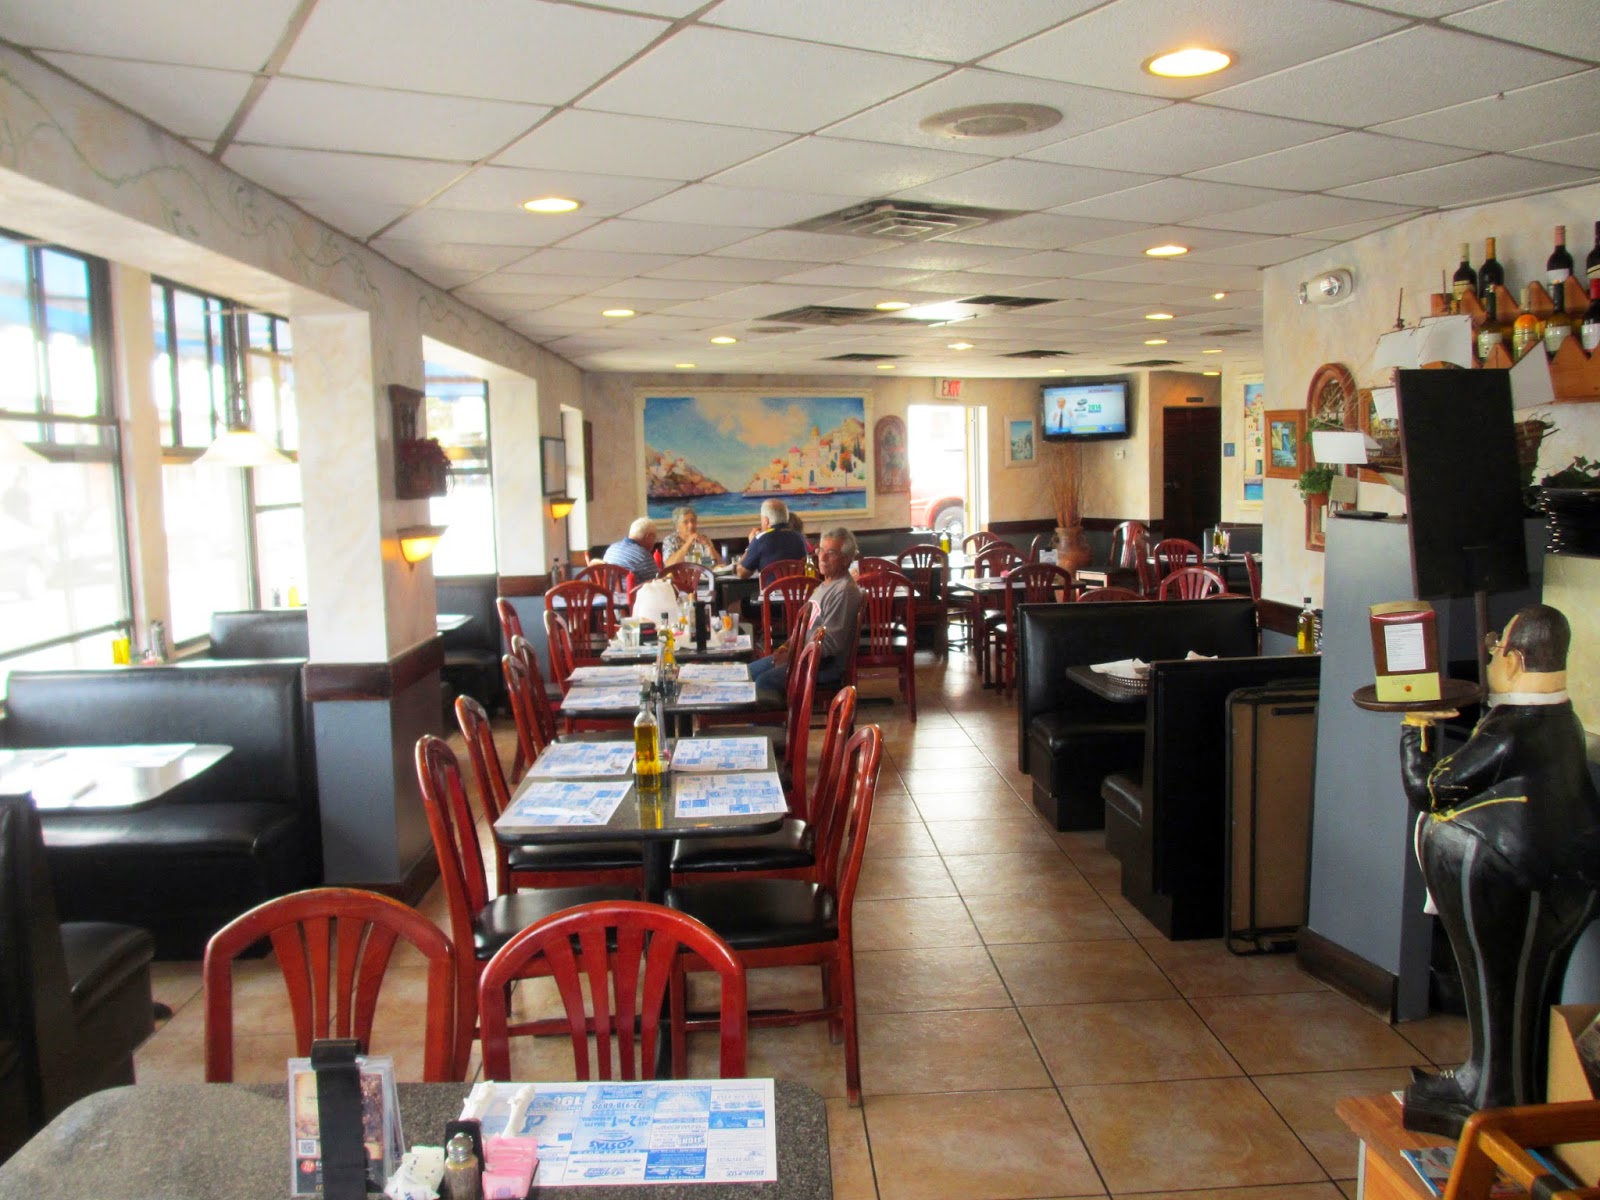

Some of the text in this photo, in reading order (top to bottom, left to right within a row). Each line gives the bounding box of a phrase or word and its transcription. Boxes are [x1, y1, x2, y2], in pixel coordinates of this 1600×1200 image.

[942, 379, 961, 397] EXIT
[610, 1116, 618, 1128] 1
[629, 1115, 637, 1127] 2
